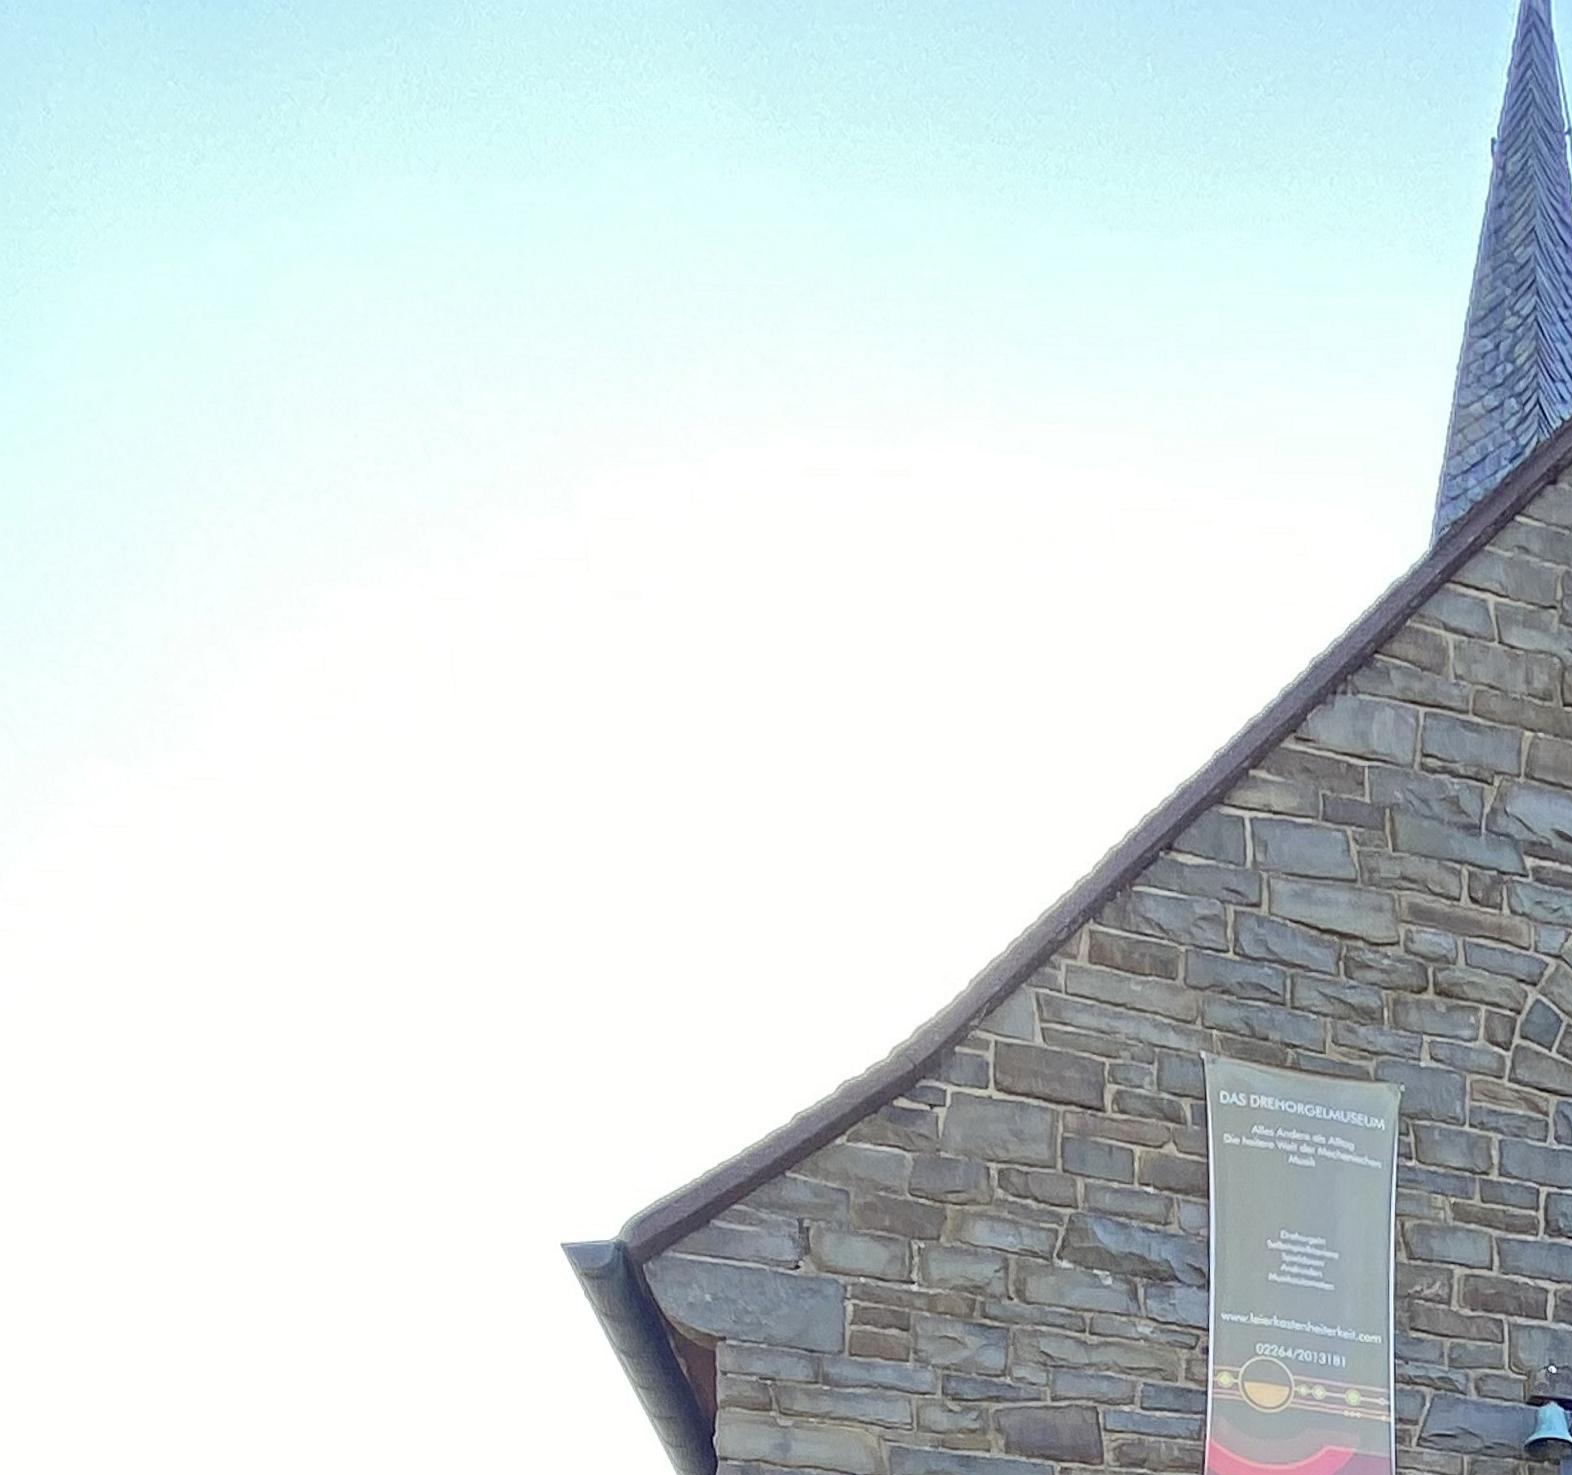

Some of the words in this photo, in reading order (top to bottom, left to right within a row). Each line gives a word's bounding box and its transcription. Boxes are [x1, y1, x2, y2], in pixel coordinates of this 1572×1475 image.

[1219, 1090, 1246, 1107] DAS
[1250, 1094, 1386, 1130] DREHORGELMUSEUM
[1255, 1343, 1346, 1368] 02264/2013181
